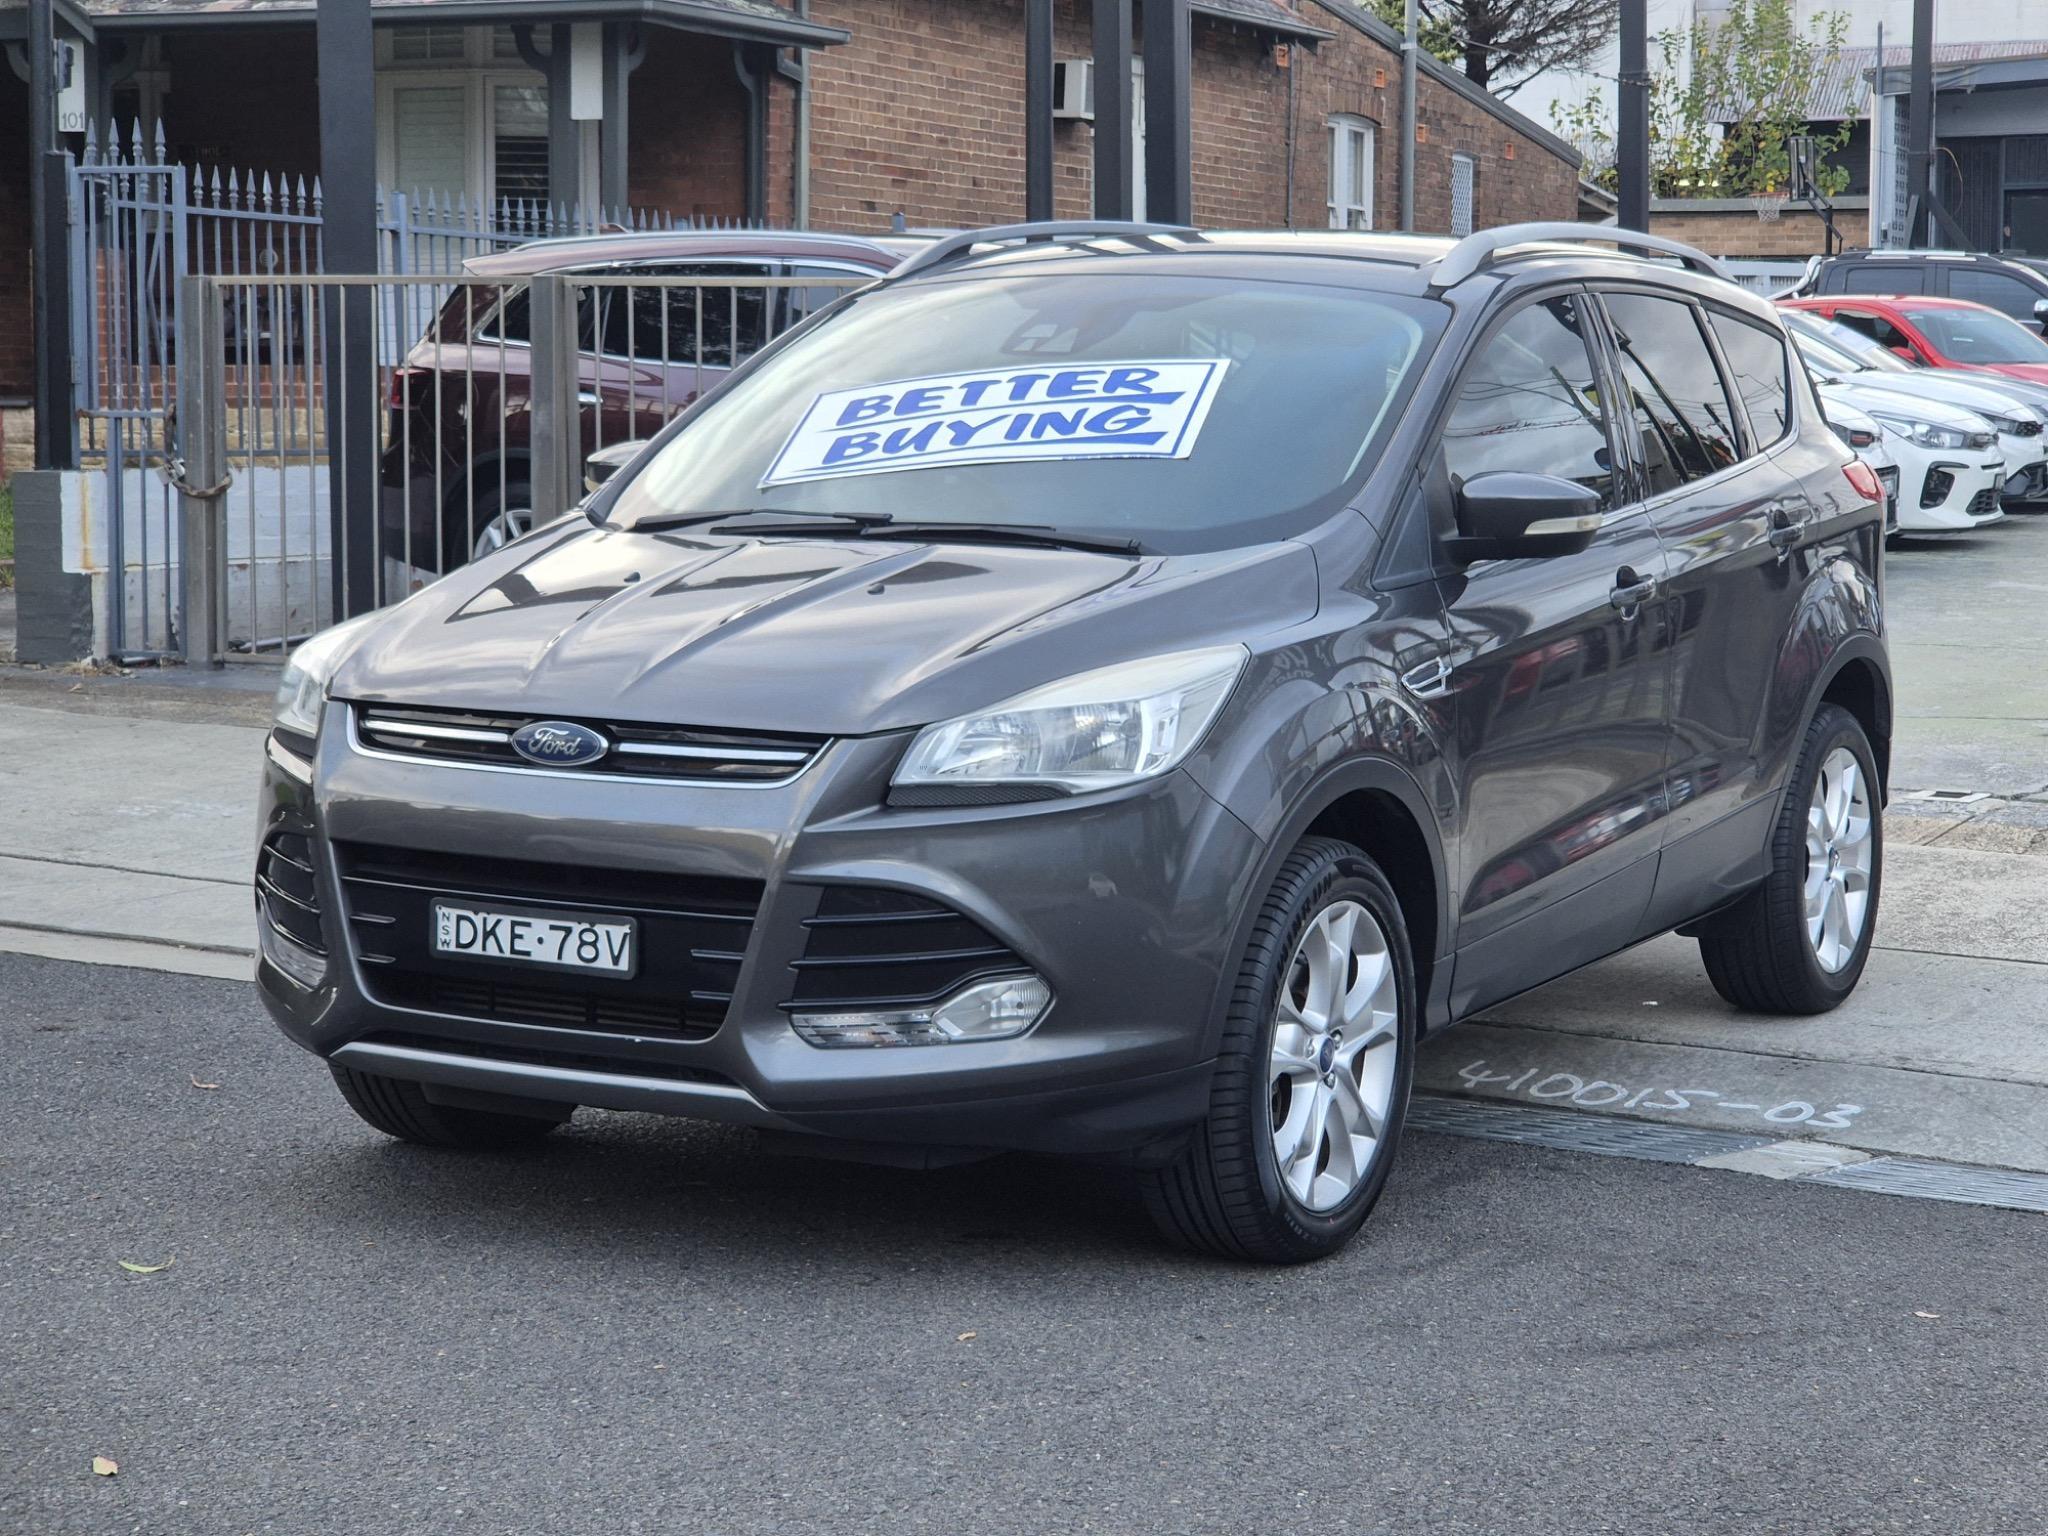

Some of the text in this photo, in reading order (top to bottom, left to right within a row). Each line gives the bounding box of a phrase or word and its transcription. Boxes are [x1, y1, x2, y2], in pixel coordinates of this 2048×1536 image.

[62, 112, 84, 129] 101
[835, 368, 1160, 426] BETTER
[821, 404, 1154, 465] BUYING
[528, 727, 582, 756] Ford
